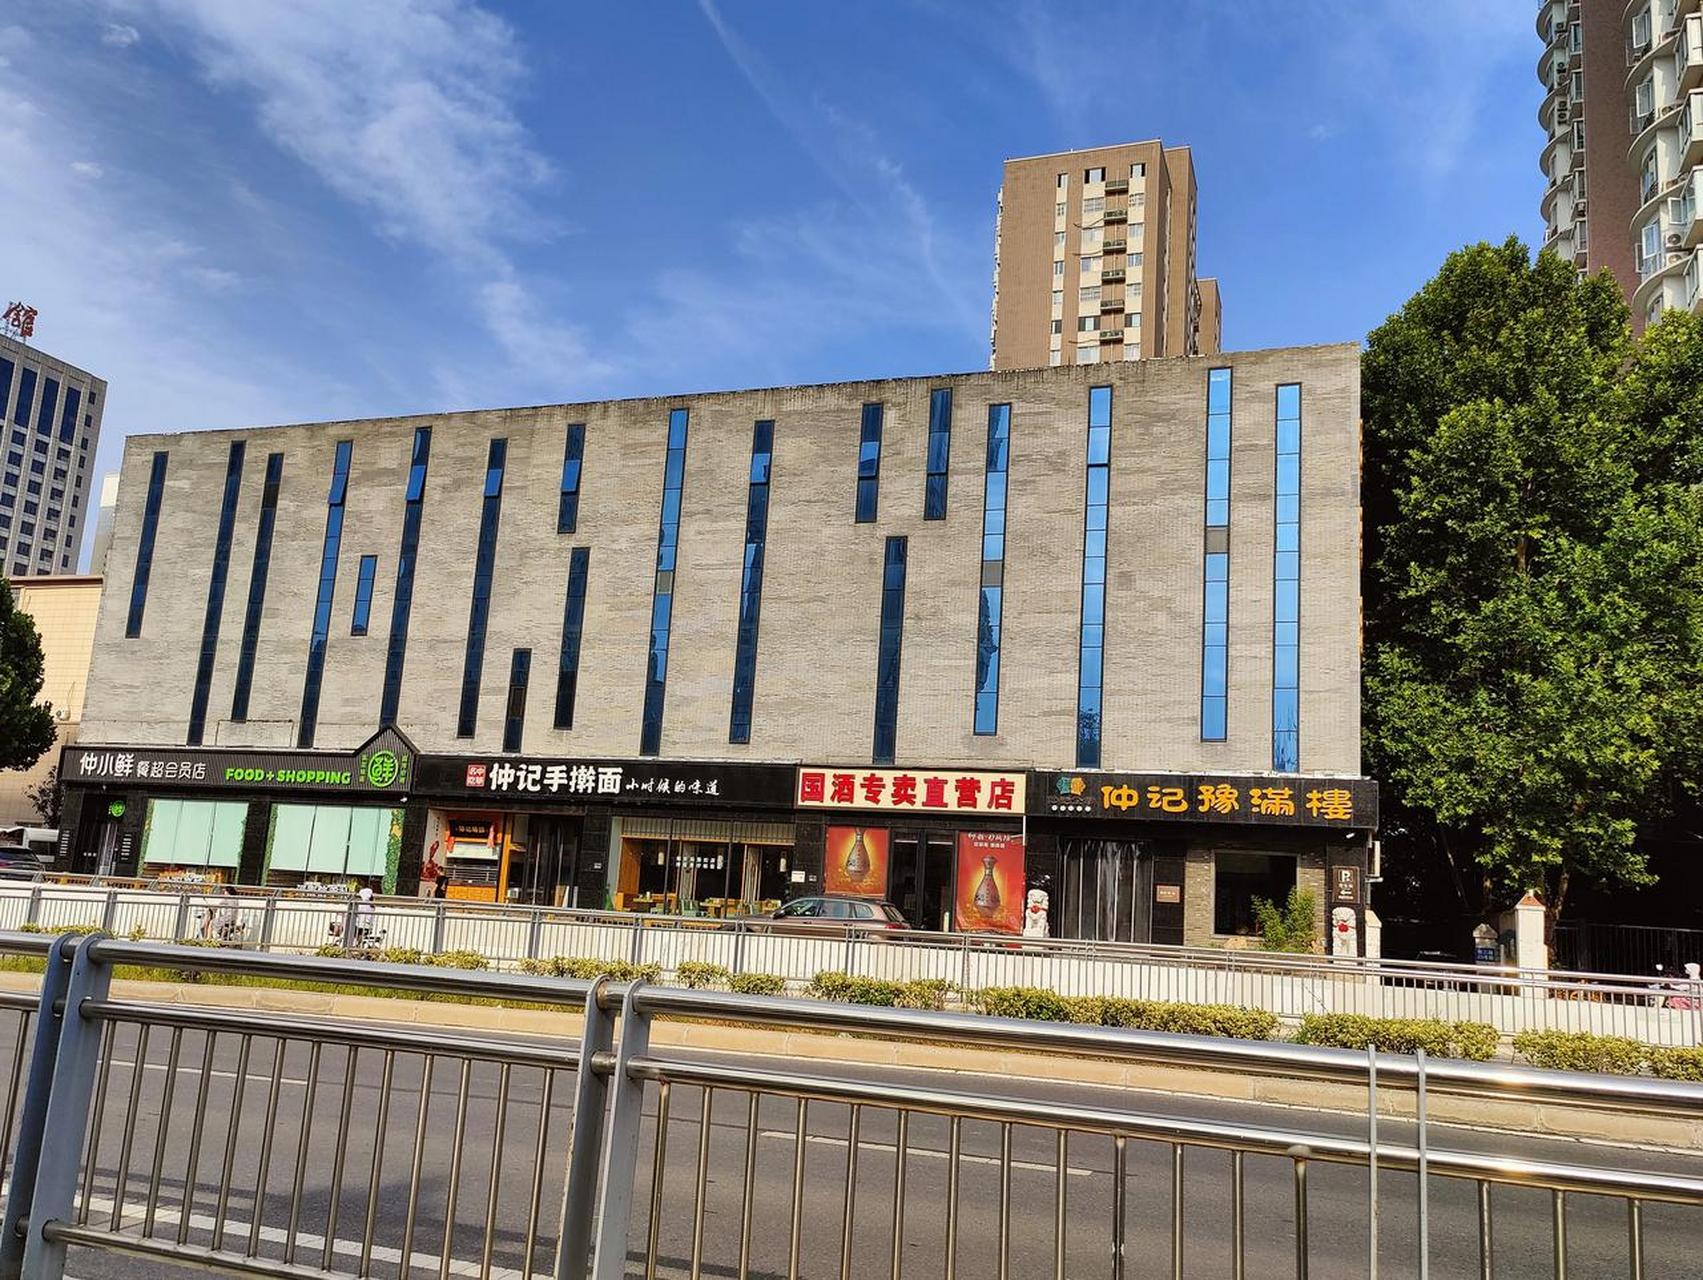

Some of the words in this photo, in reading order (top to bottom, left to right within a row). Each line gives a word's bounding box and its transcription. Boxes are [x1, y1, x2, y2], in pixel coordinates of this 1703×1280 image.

[79, 751, 136, 777] 仲小鲜
[137, 760, 207, 780] 餐超会员店
[488, 762, 623, 795] 仲记手擀面
[625, 777, 721, 796] 小时候的味道
[800, 771, 1016, 811] 国酒专卖直营店
